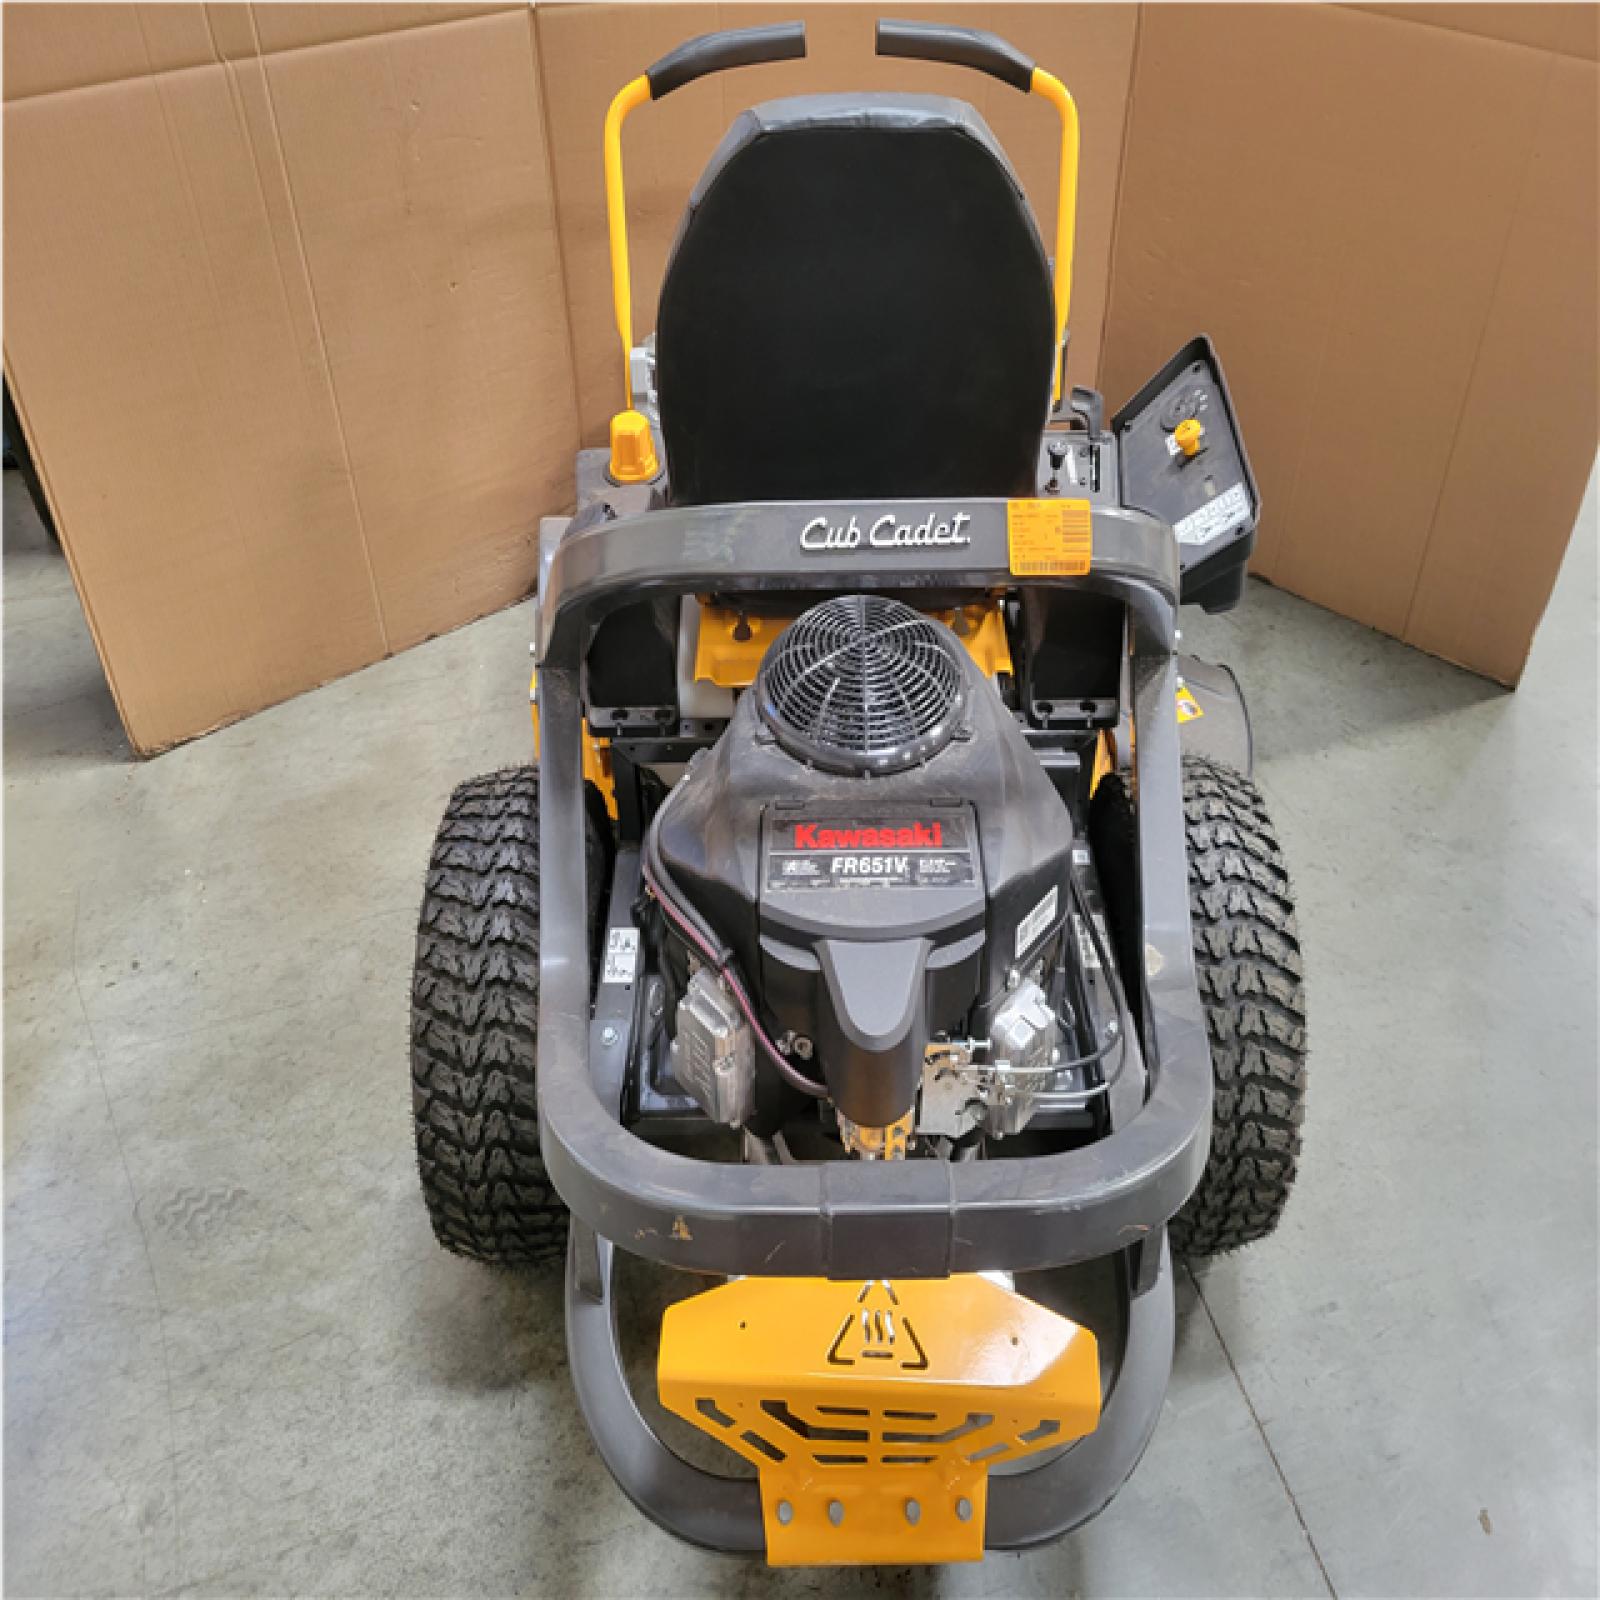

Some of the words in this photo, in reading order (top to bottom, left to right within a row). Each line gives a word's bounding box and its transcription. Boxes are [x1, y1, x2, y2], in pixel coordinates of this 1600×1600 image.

[801, 516, 860, 549] Cub
[794, 821, 943, 848] Kawasaki
[831, 856, 908, 874] FR651V
